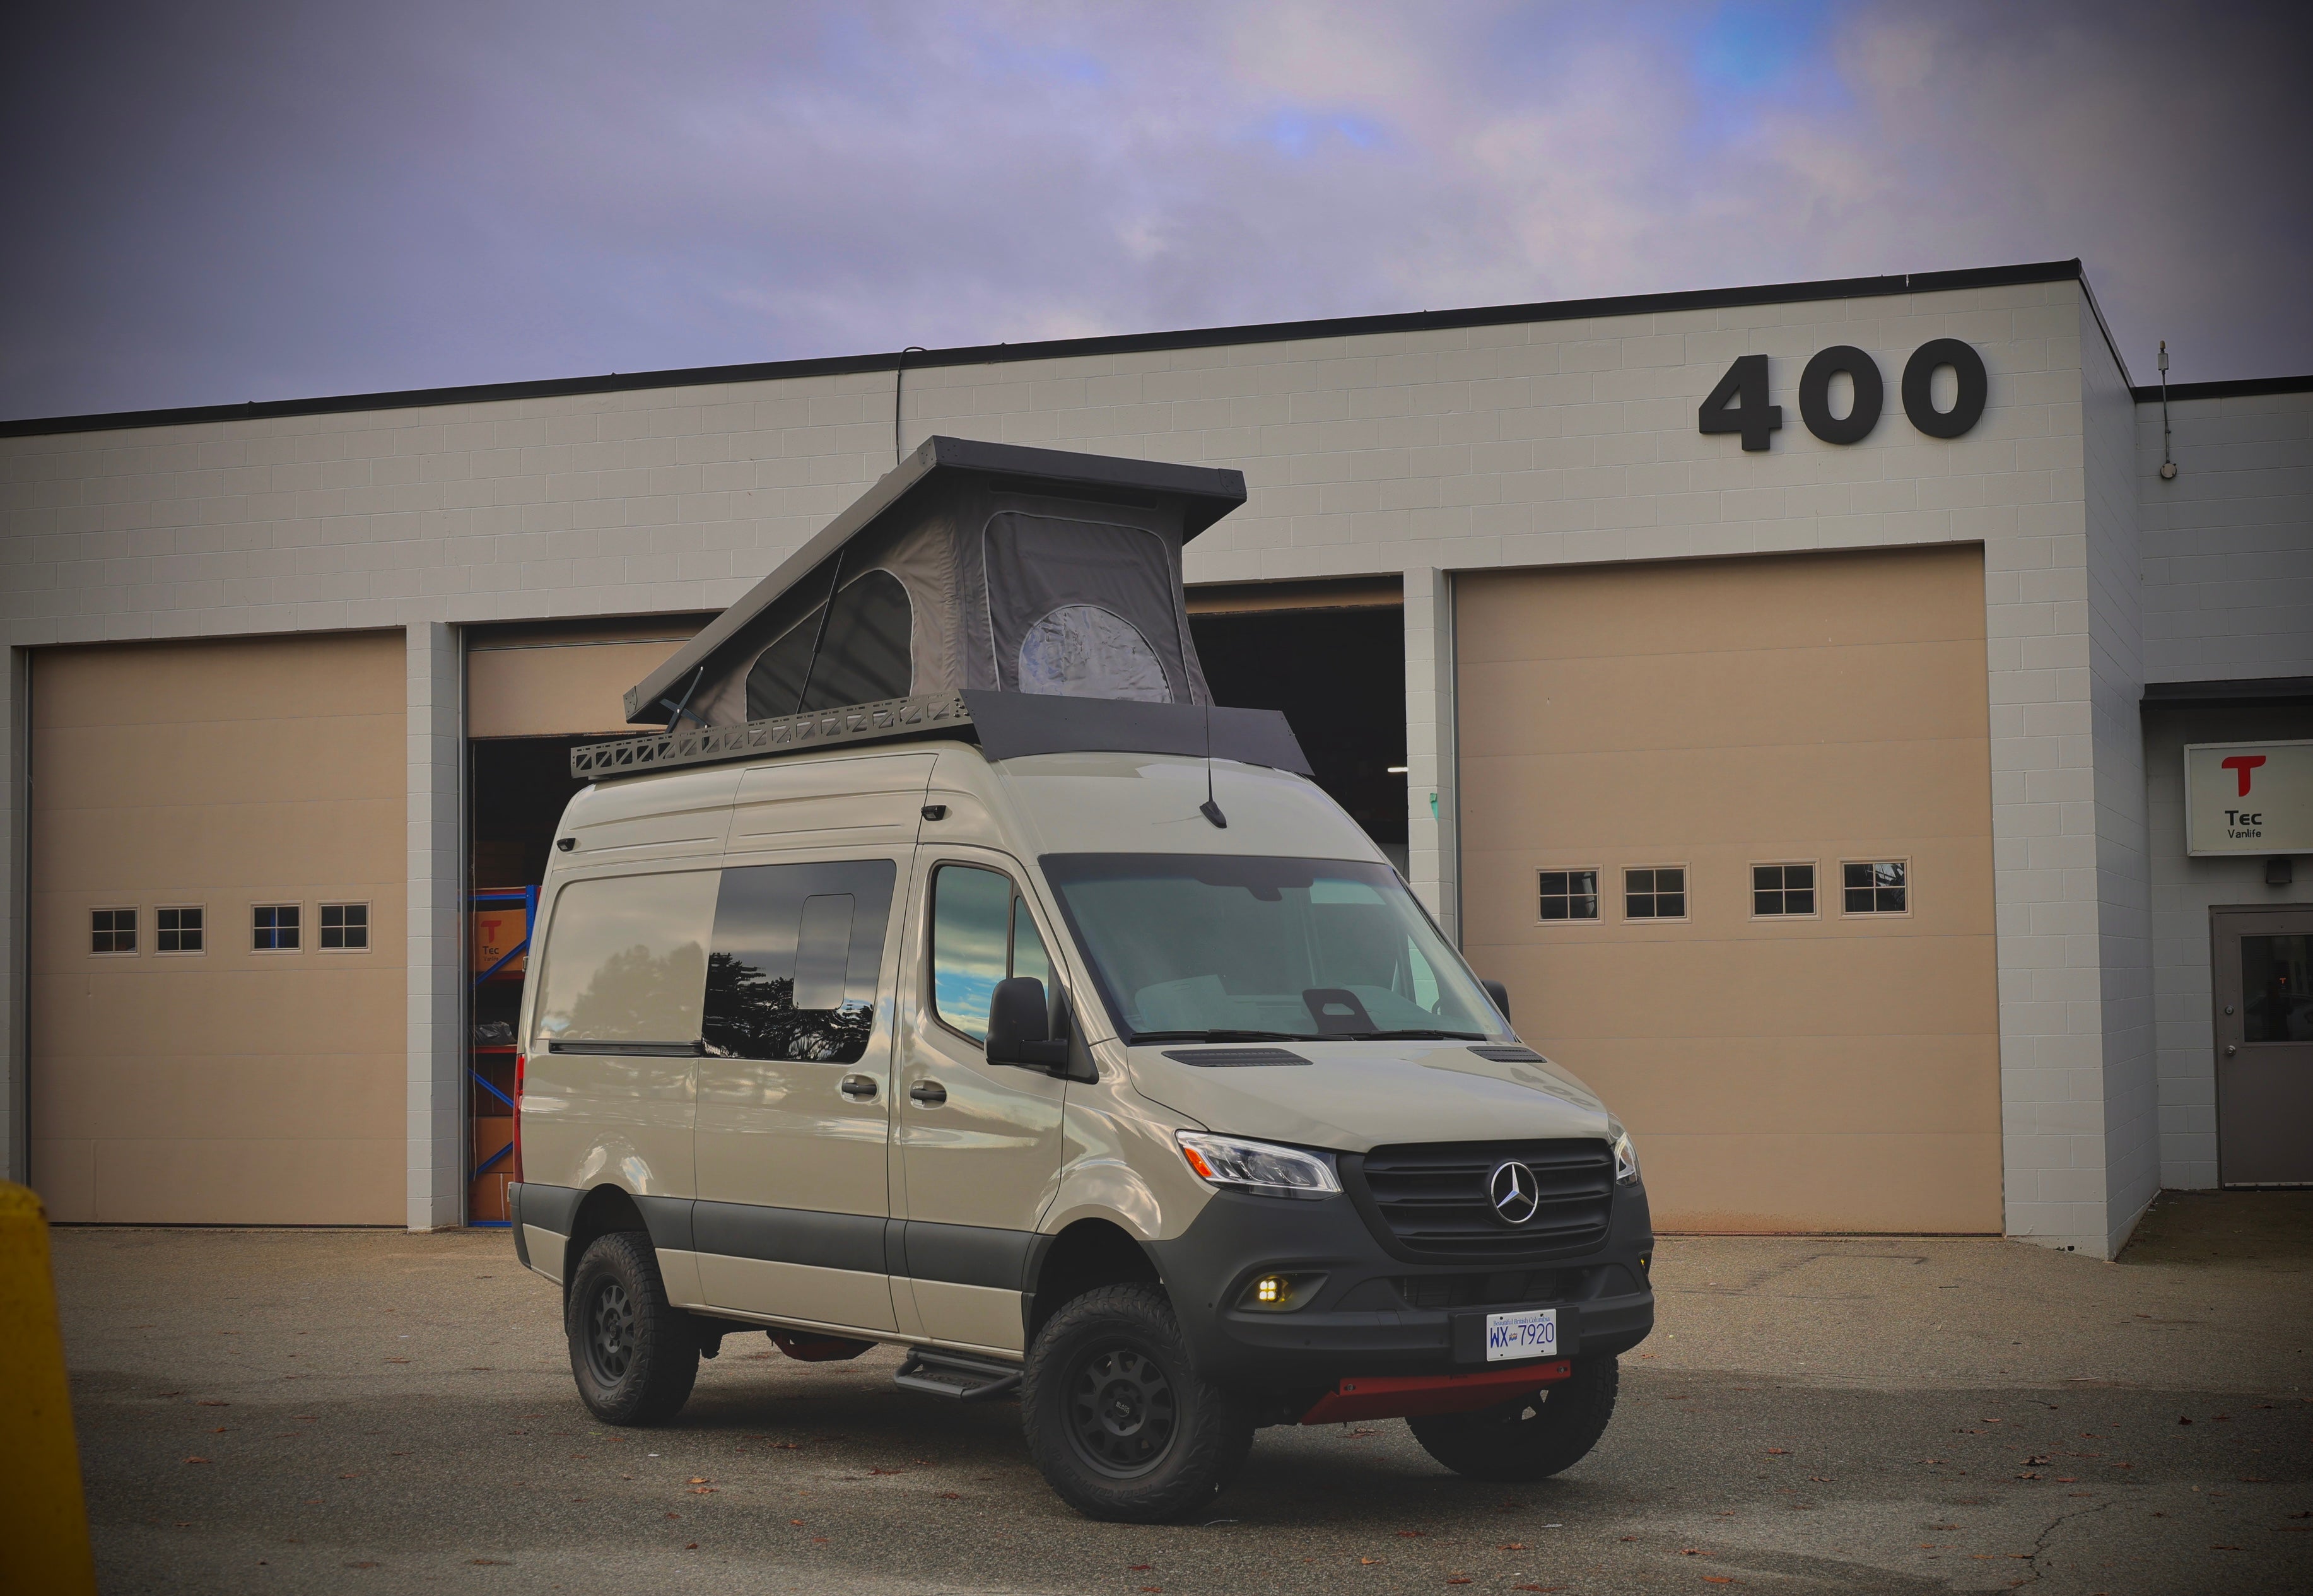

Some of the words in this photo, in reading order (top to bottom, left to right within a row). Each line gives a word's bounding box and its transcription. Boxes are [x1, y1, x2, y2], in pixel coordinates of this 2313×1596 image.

[1698, 338, 1988, 451] 400
[2221, 755, 2266, 797] T
[2225, 810, 2262, 826] Tec
[2227, 829, 2261, 838] Vanlife
[483, 946, 499, 954] Tec
[1490, 1326, 1508, 1348] WX
[1518, 1322, 1554, 1346] 7920
[1116, 1400, 1130, 1410] BLACK
[1116, 1404, 1130, 1414] RHINO
